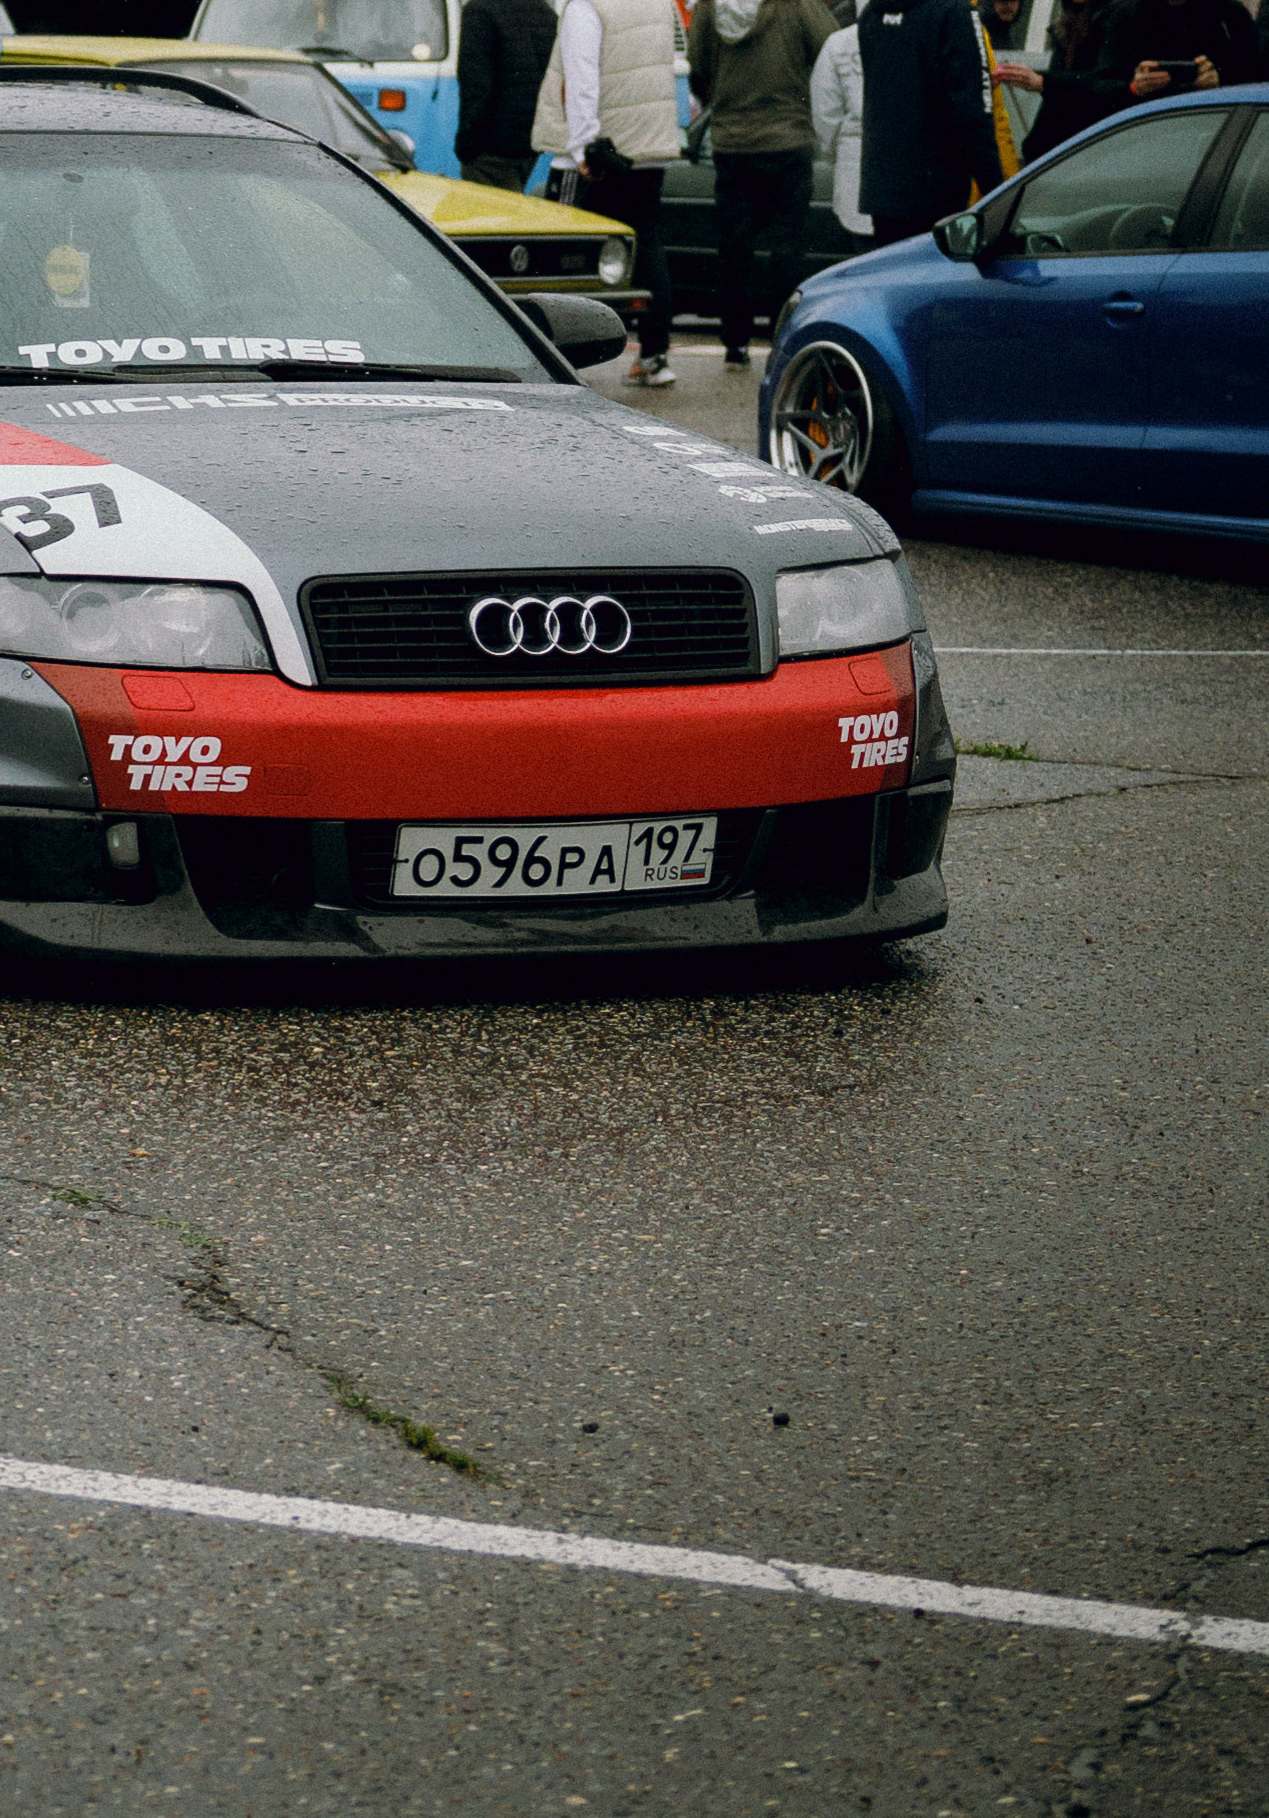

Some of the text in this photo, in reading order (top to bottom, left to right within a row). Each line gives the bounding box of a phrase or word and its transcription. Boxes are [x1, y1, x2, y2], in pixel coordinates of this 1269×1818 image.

[18, 337, 366, 369] TOYO TIRES
[287, 394, 506, 410] PRODUCTS
[837, 710, 899, 743] TOYO
[107, 734, 222, 764] TOYO
[850, 736, 909, 770] TIRES
[126, 764, 252, 793] TIRES
[633, 822, 705, 866] 197
[643, 865, 680, 883] RUS
